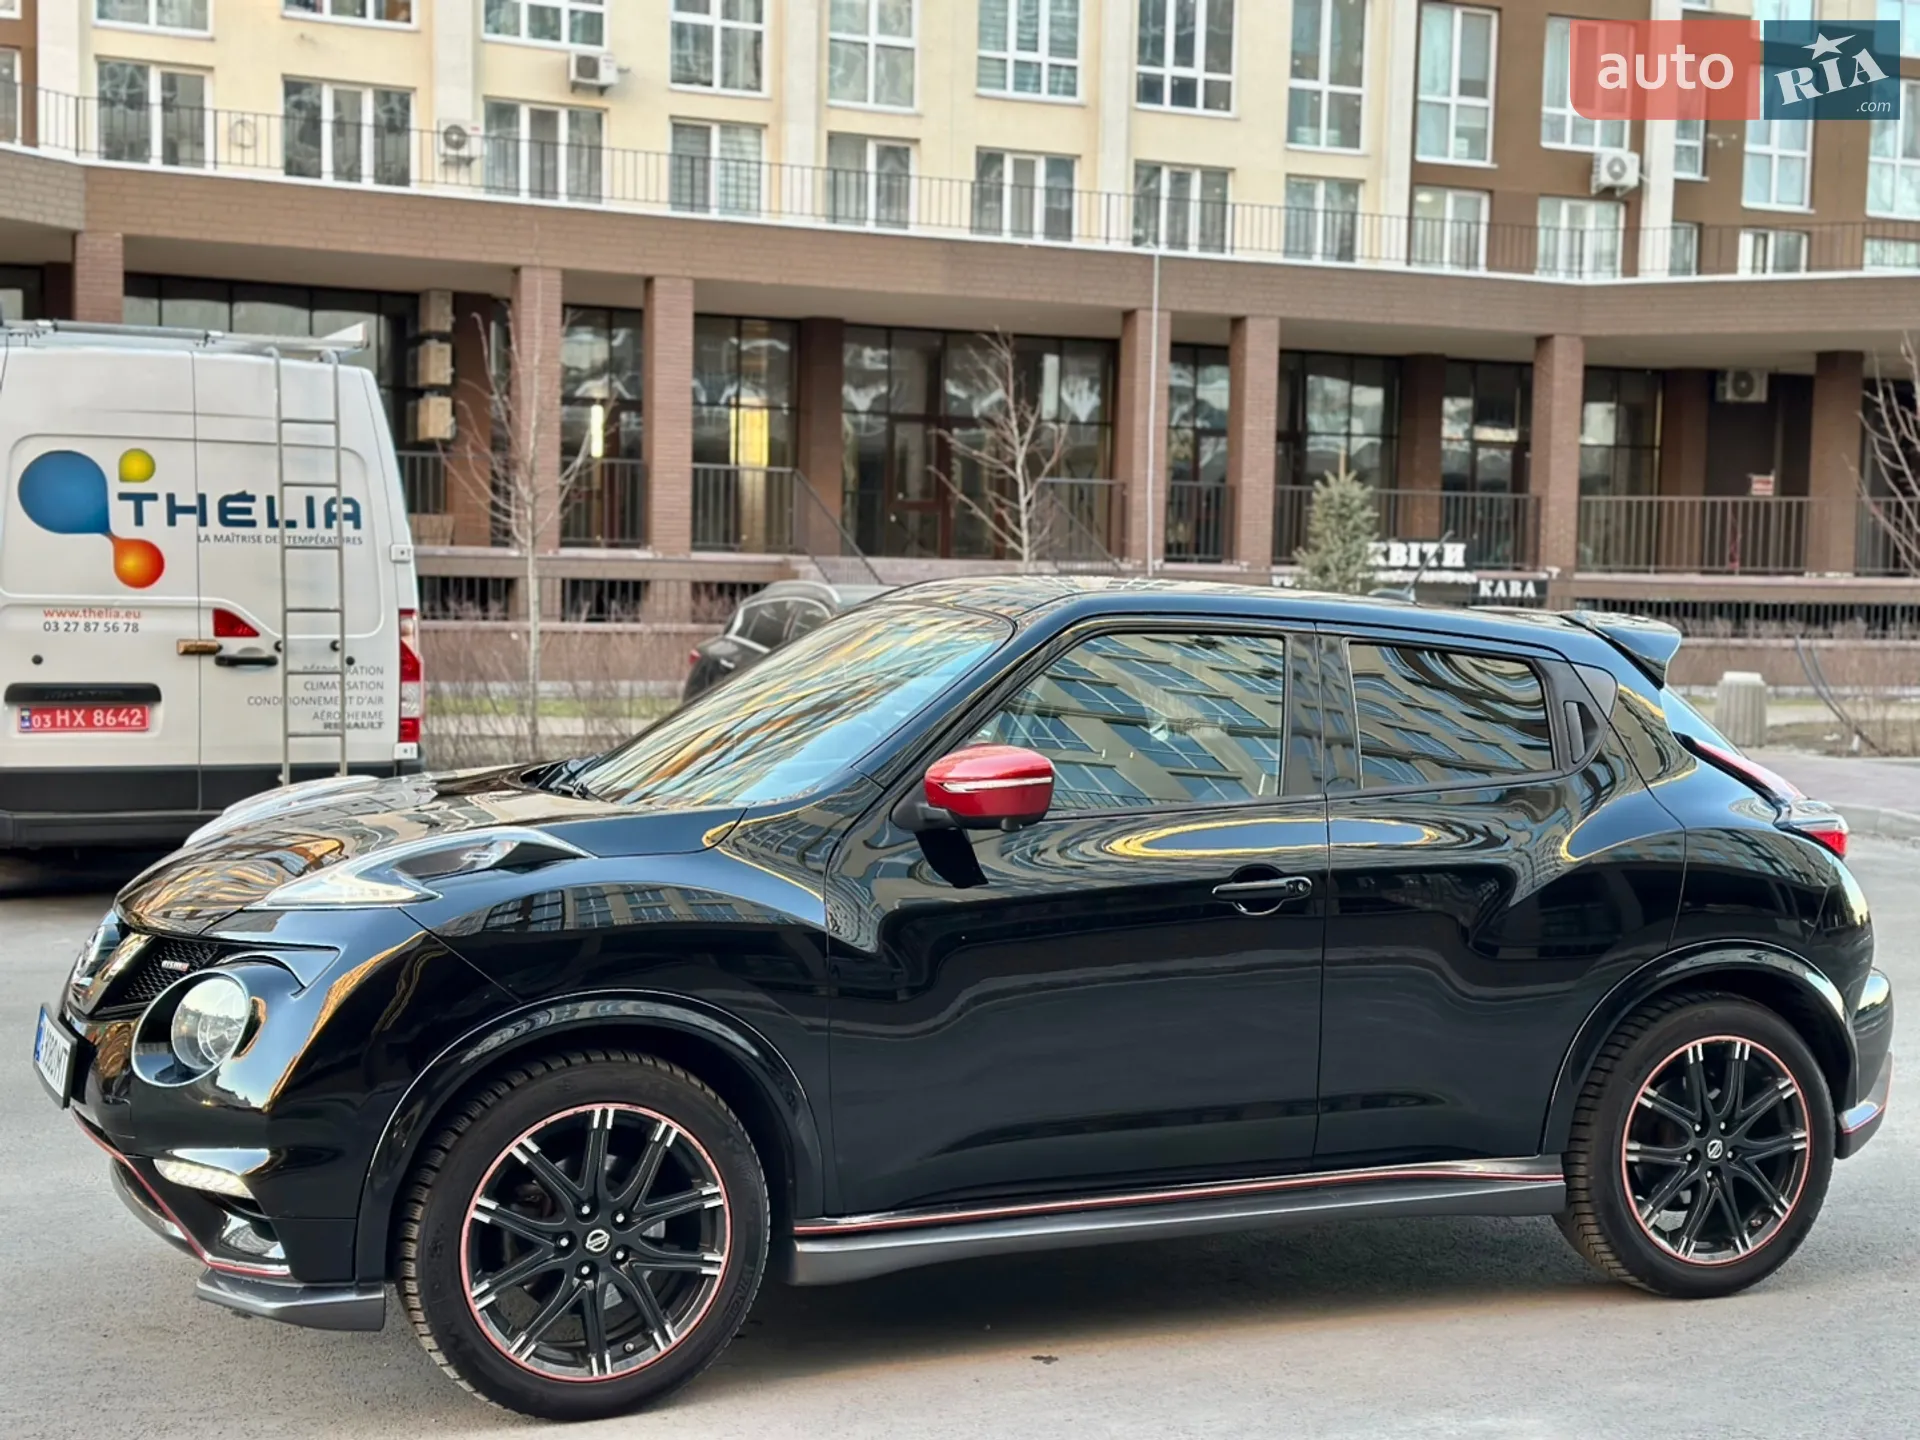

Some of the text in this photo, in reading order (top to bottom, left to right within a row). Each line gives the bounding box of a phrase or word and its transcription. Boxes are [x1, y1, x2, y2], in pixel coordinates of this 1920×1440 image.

[117, 490, 362, 530] THÉLIA
[198, 533, 213, 543] LA
[214, 531, 261, 544] MAÎTRISE
[1366, 542, 1466, 567] КВІТИ
[43, 608, 141, 619] www.thelia.eu
[43, 621, 139, 633] 03 27 87 56 78
[303, 680, 384, 691] CLIMATSATION
[247, 695, 353, 706] CONDIIONNEMET
[31, 715, 51, 728] 03
[56, 709, 85, 727] HX
[93, 708, 143, 726] 8642
[312, 710, 384, 721] AÉROHERME
